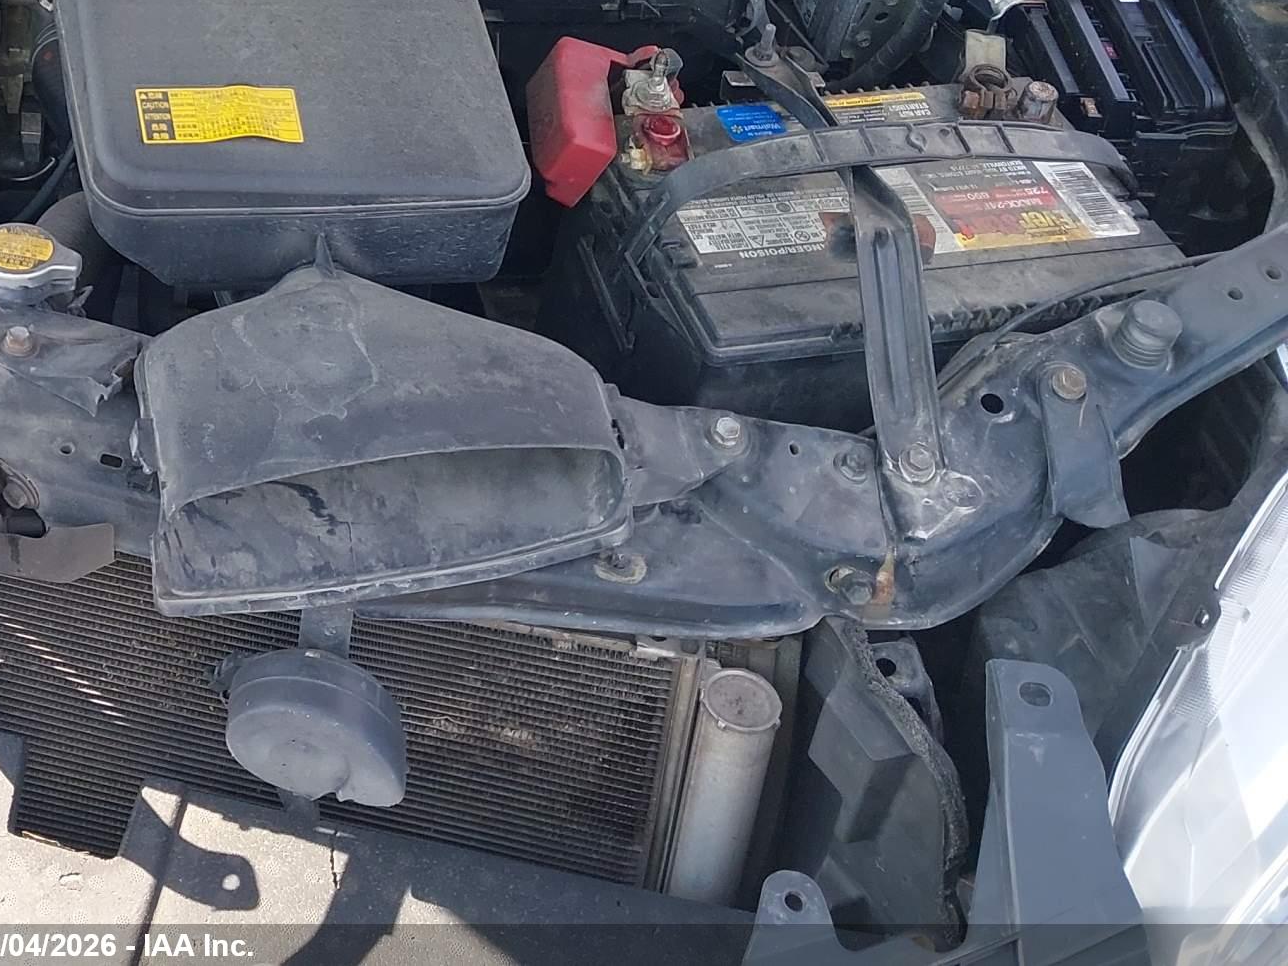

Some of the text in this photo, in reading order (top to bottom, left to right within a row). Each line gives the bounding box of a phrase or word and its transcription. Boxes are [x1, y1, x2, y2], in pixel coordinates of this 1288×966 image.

[743, 123, 781, 131] Walmart
[1025, 186, 1049, 194] 725
[739, 243, 825, 258] ANGER/POISON
